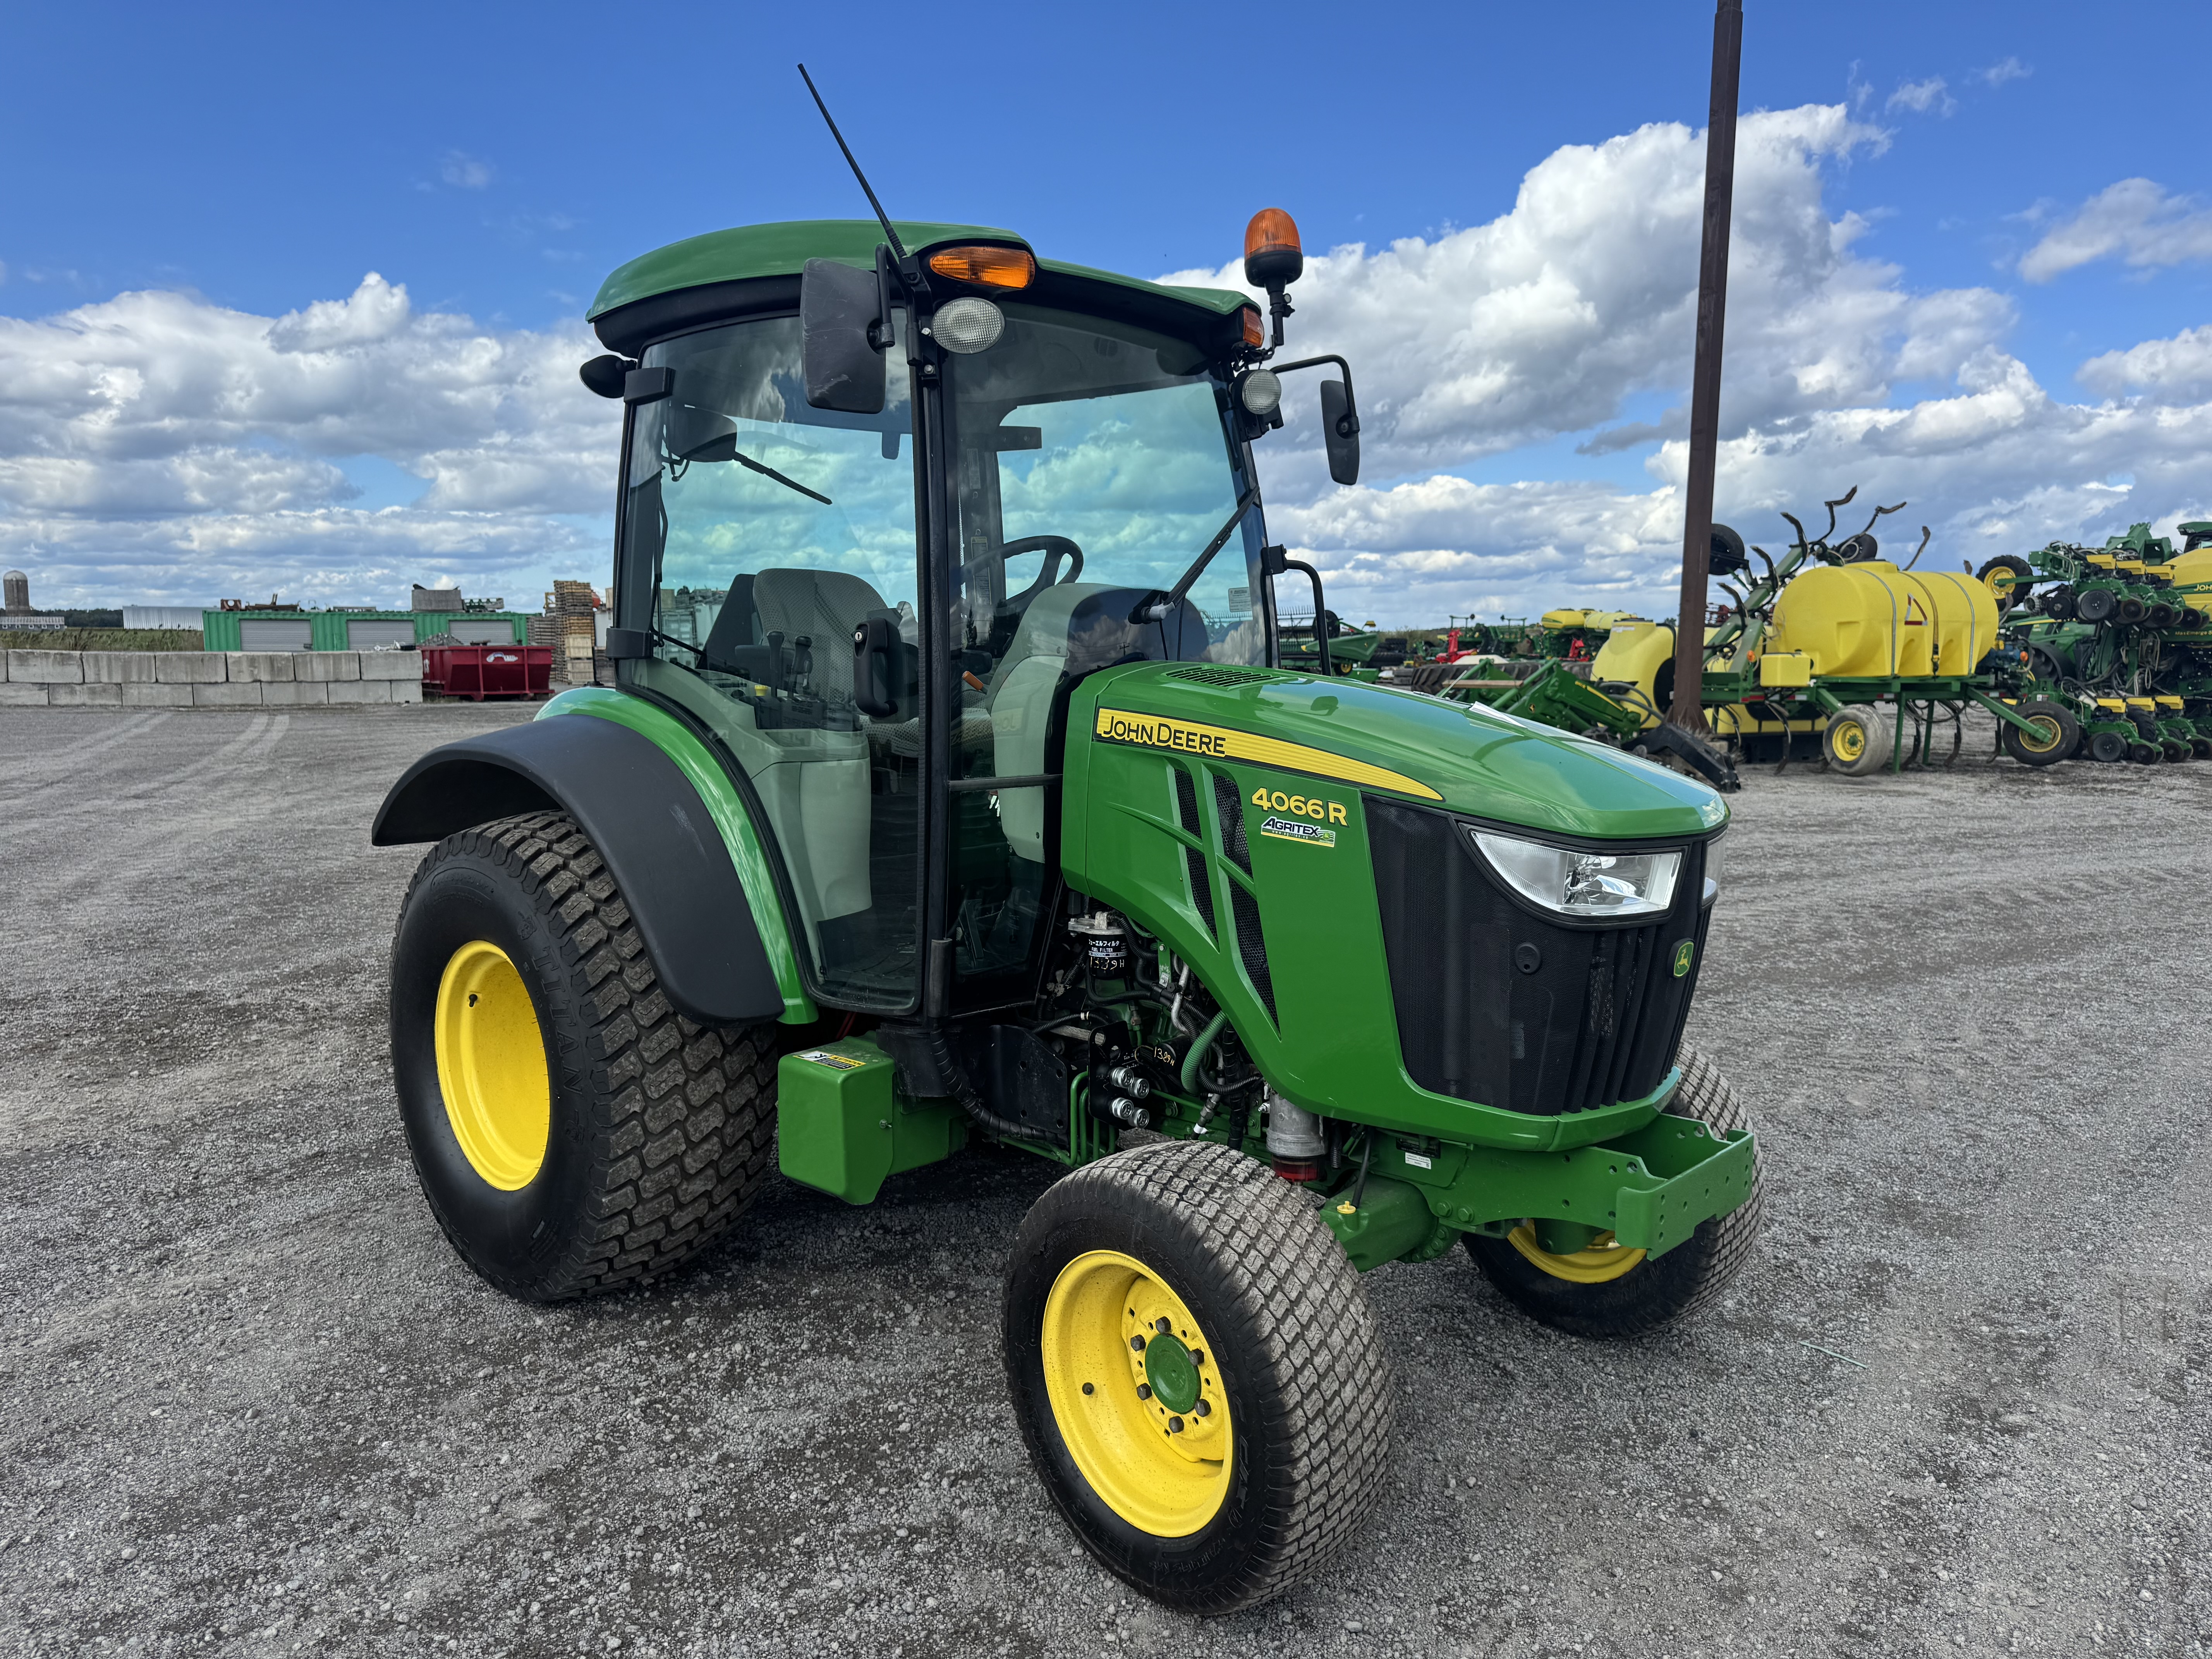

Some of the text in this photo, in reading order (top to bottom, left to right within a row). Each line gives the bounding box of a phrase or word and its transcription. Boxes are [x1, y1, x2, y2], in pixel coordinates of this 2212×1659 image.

[1103, 716, 1226, 754] JOHN DEERE
[1263, 818, 1319, 836] AGRITEX
[531, 946, 583, 1095] TITAN
